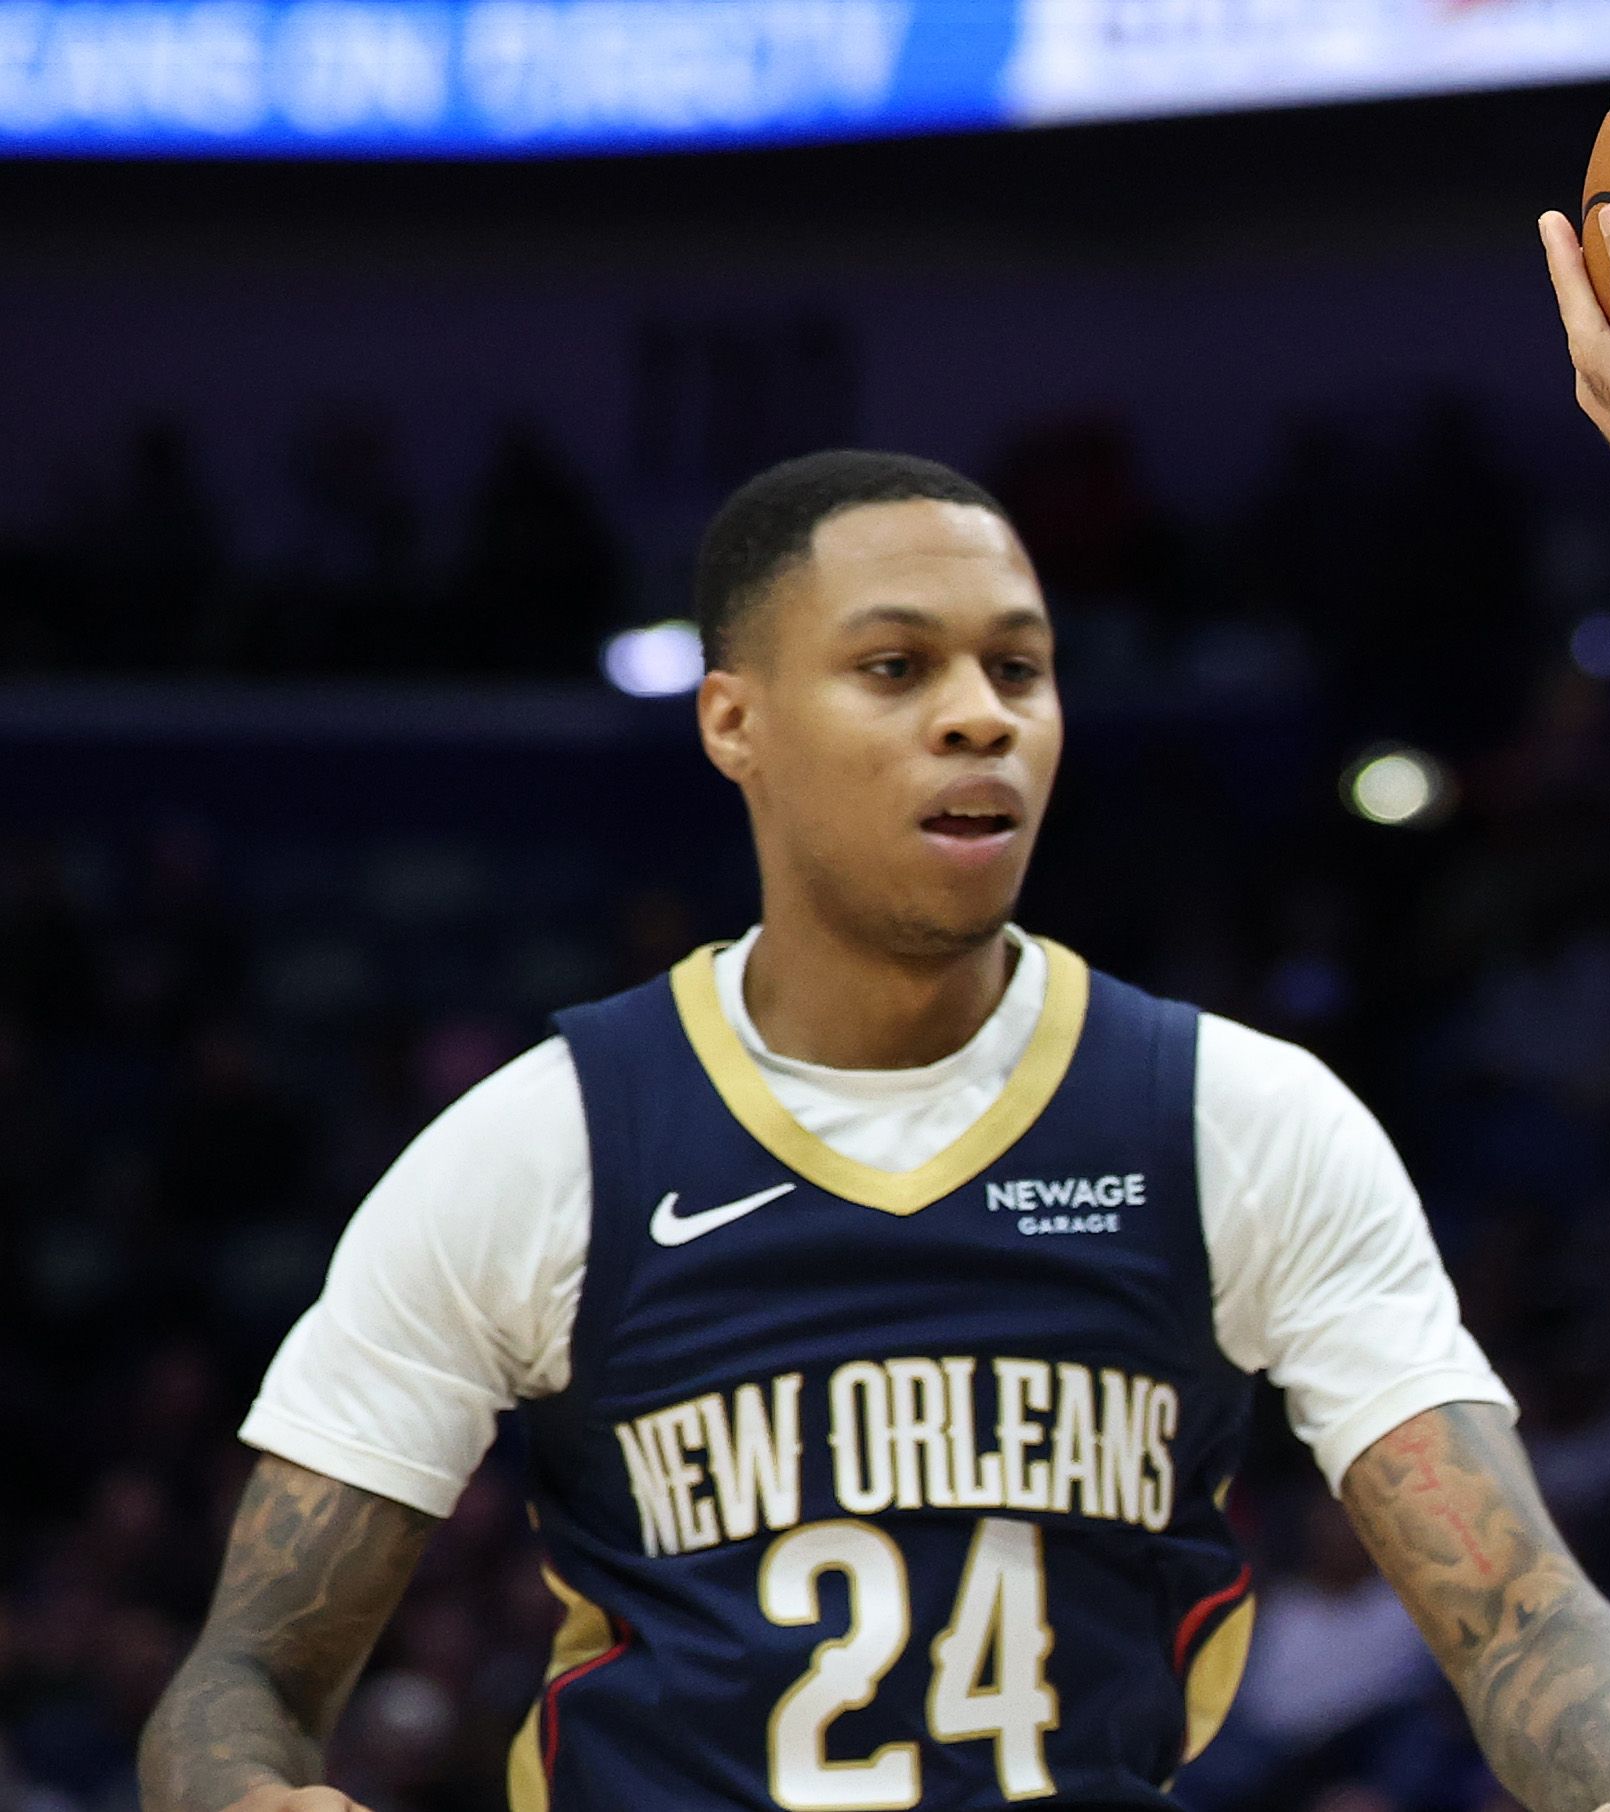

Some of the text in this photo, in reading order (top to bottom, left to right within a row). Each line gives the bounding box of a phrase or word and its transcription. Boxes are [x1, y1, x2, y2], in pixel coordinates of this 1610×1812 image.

[985, 1173, 1147, 1212] NEWAGE
[1017, 1212, 1121, 1236] GARAGE
[615, 1356, 1179, 1558] NEW ORLEANS
[757, 1517, 1060, 1811] 24
